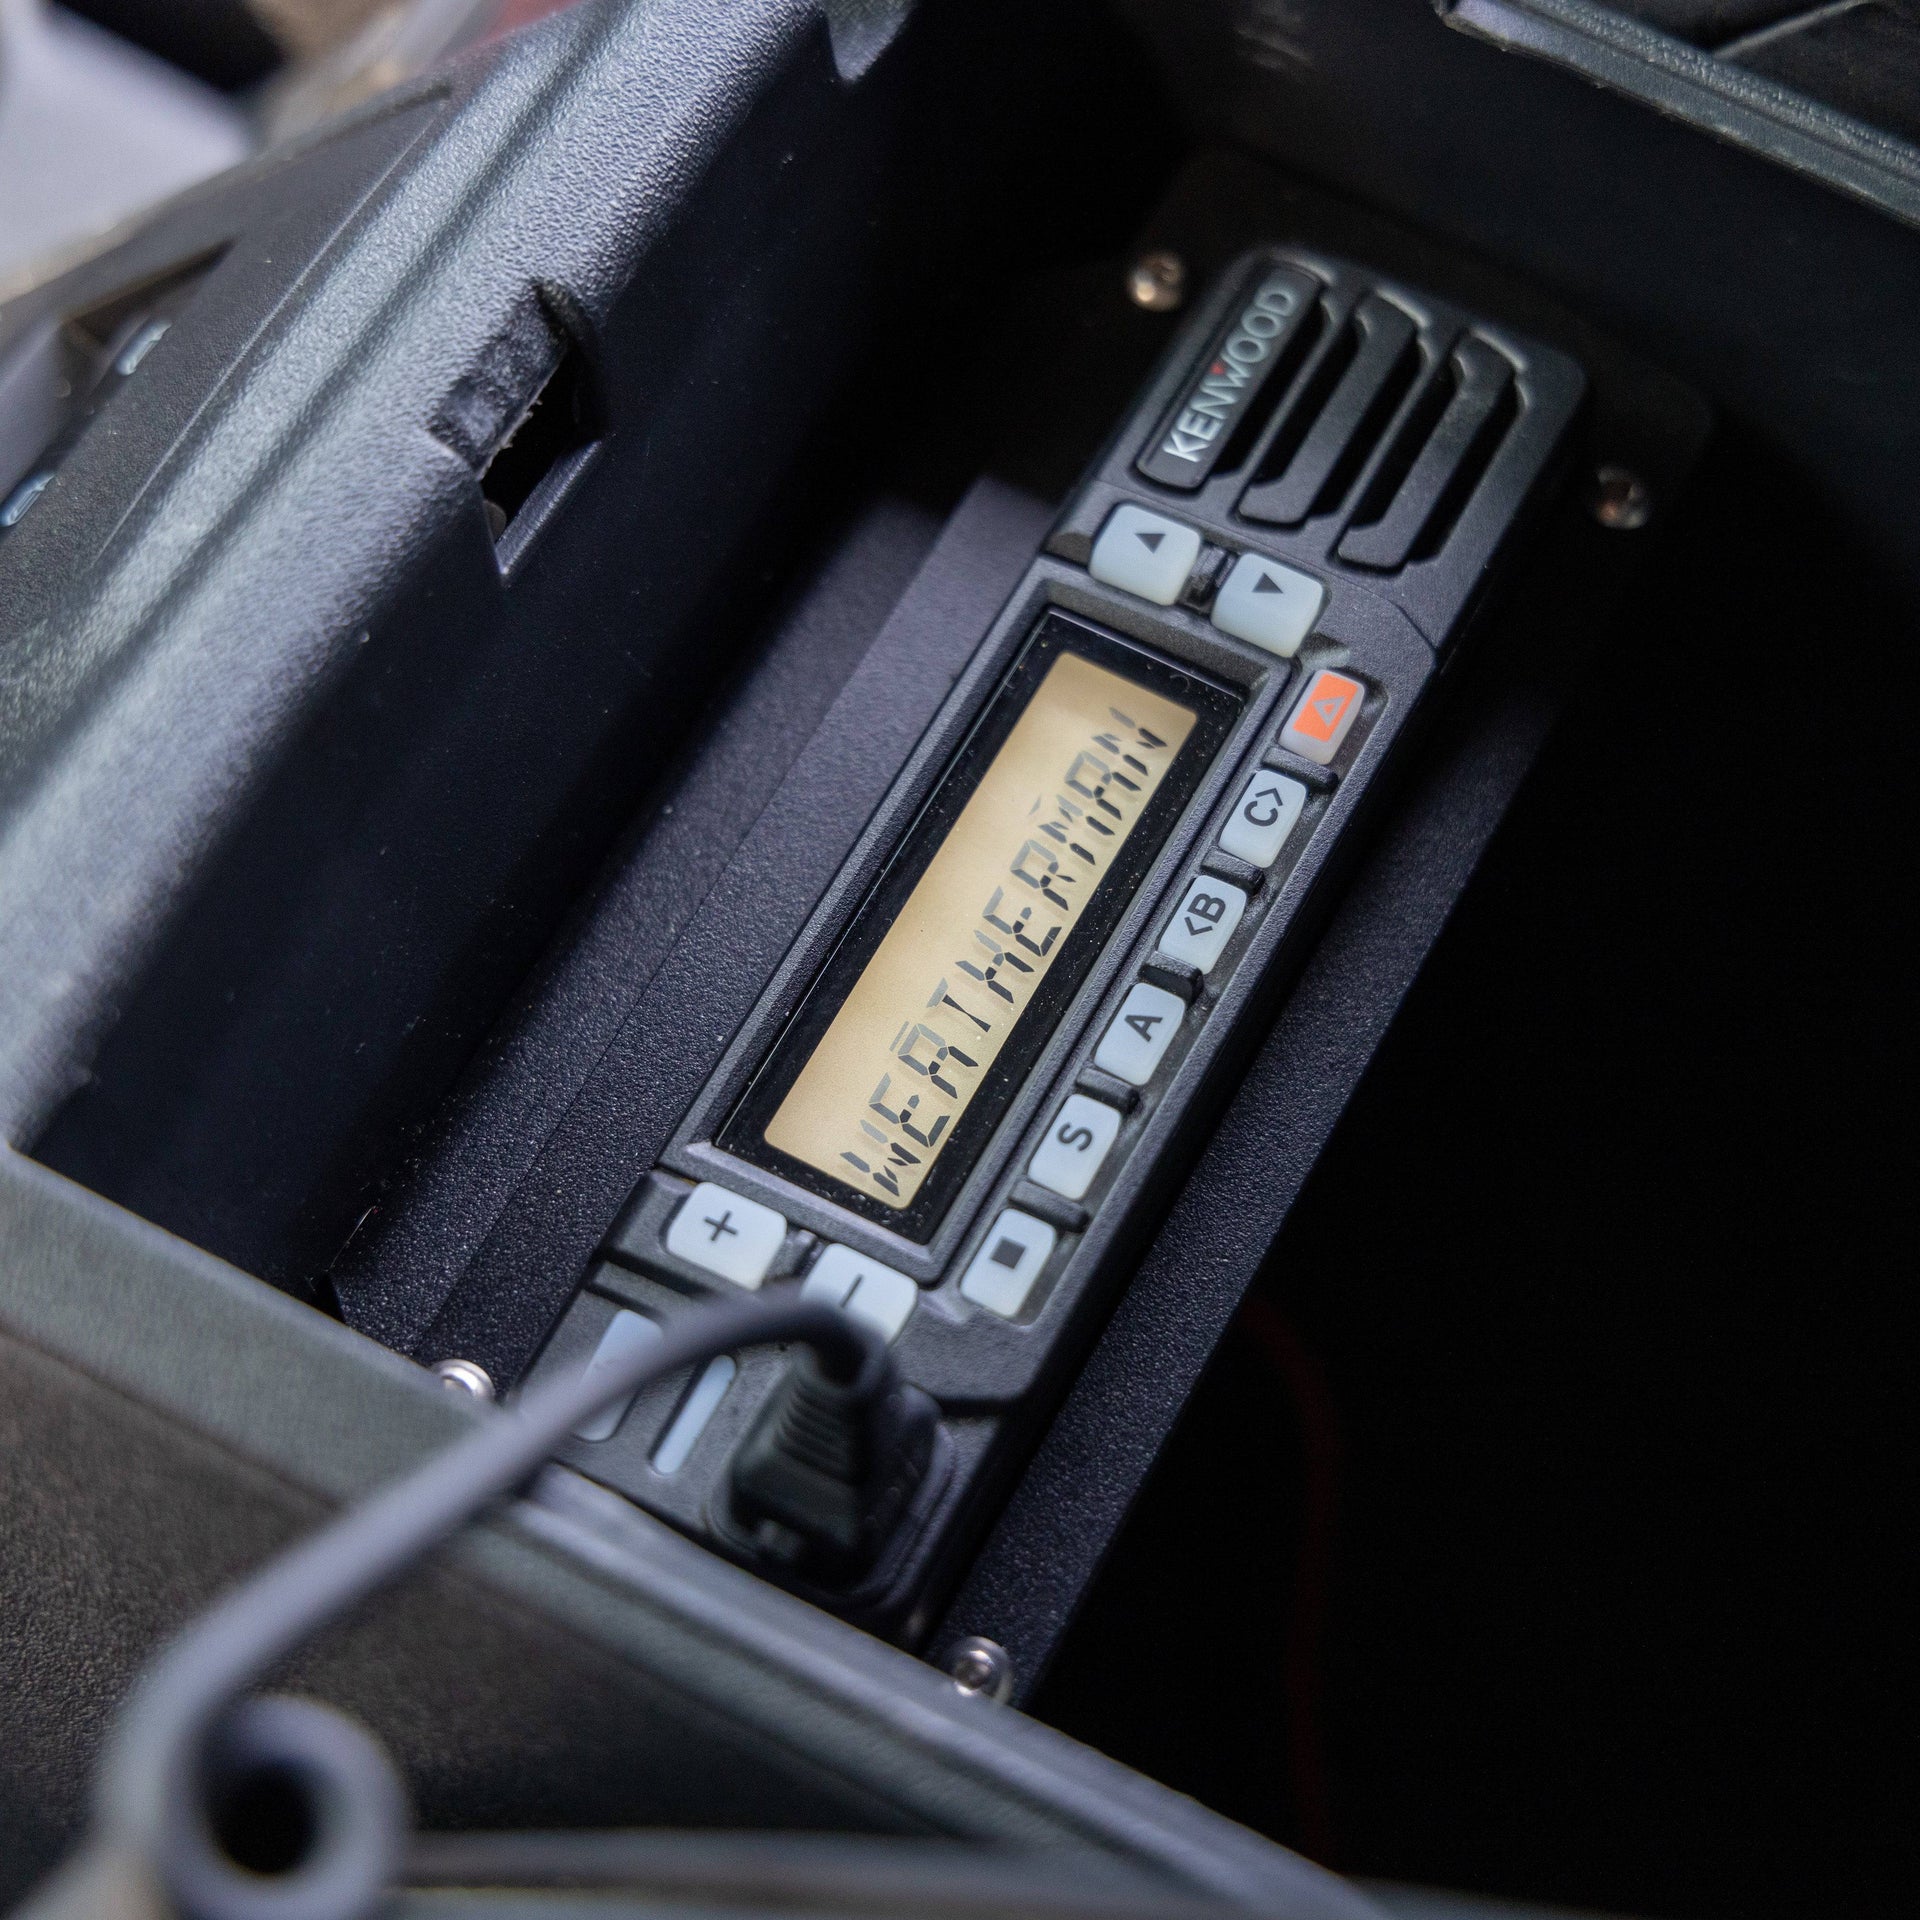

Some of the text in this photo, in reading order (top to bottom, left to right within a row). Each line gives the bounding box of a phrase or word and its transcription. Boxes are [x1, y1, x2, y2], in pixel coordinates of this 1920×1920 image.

[1163, 284, 1295, 462] KENWOOD
[841, 707, 1167, 1196] WEATHERMAN
[1124, 1013, 1163, 1041] A
[1059, 1121, 1093, 1152] S
